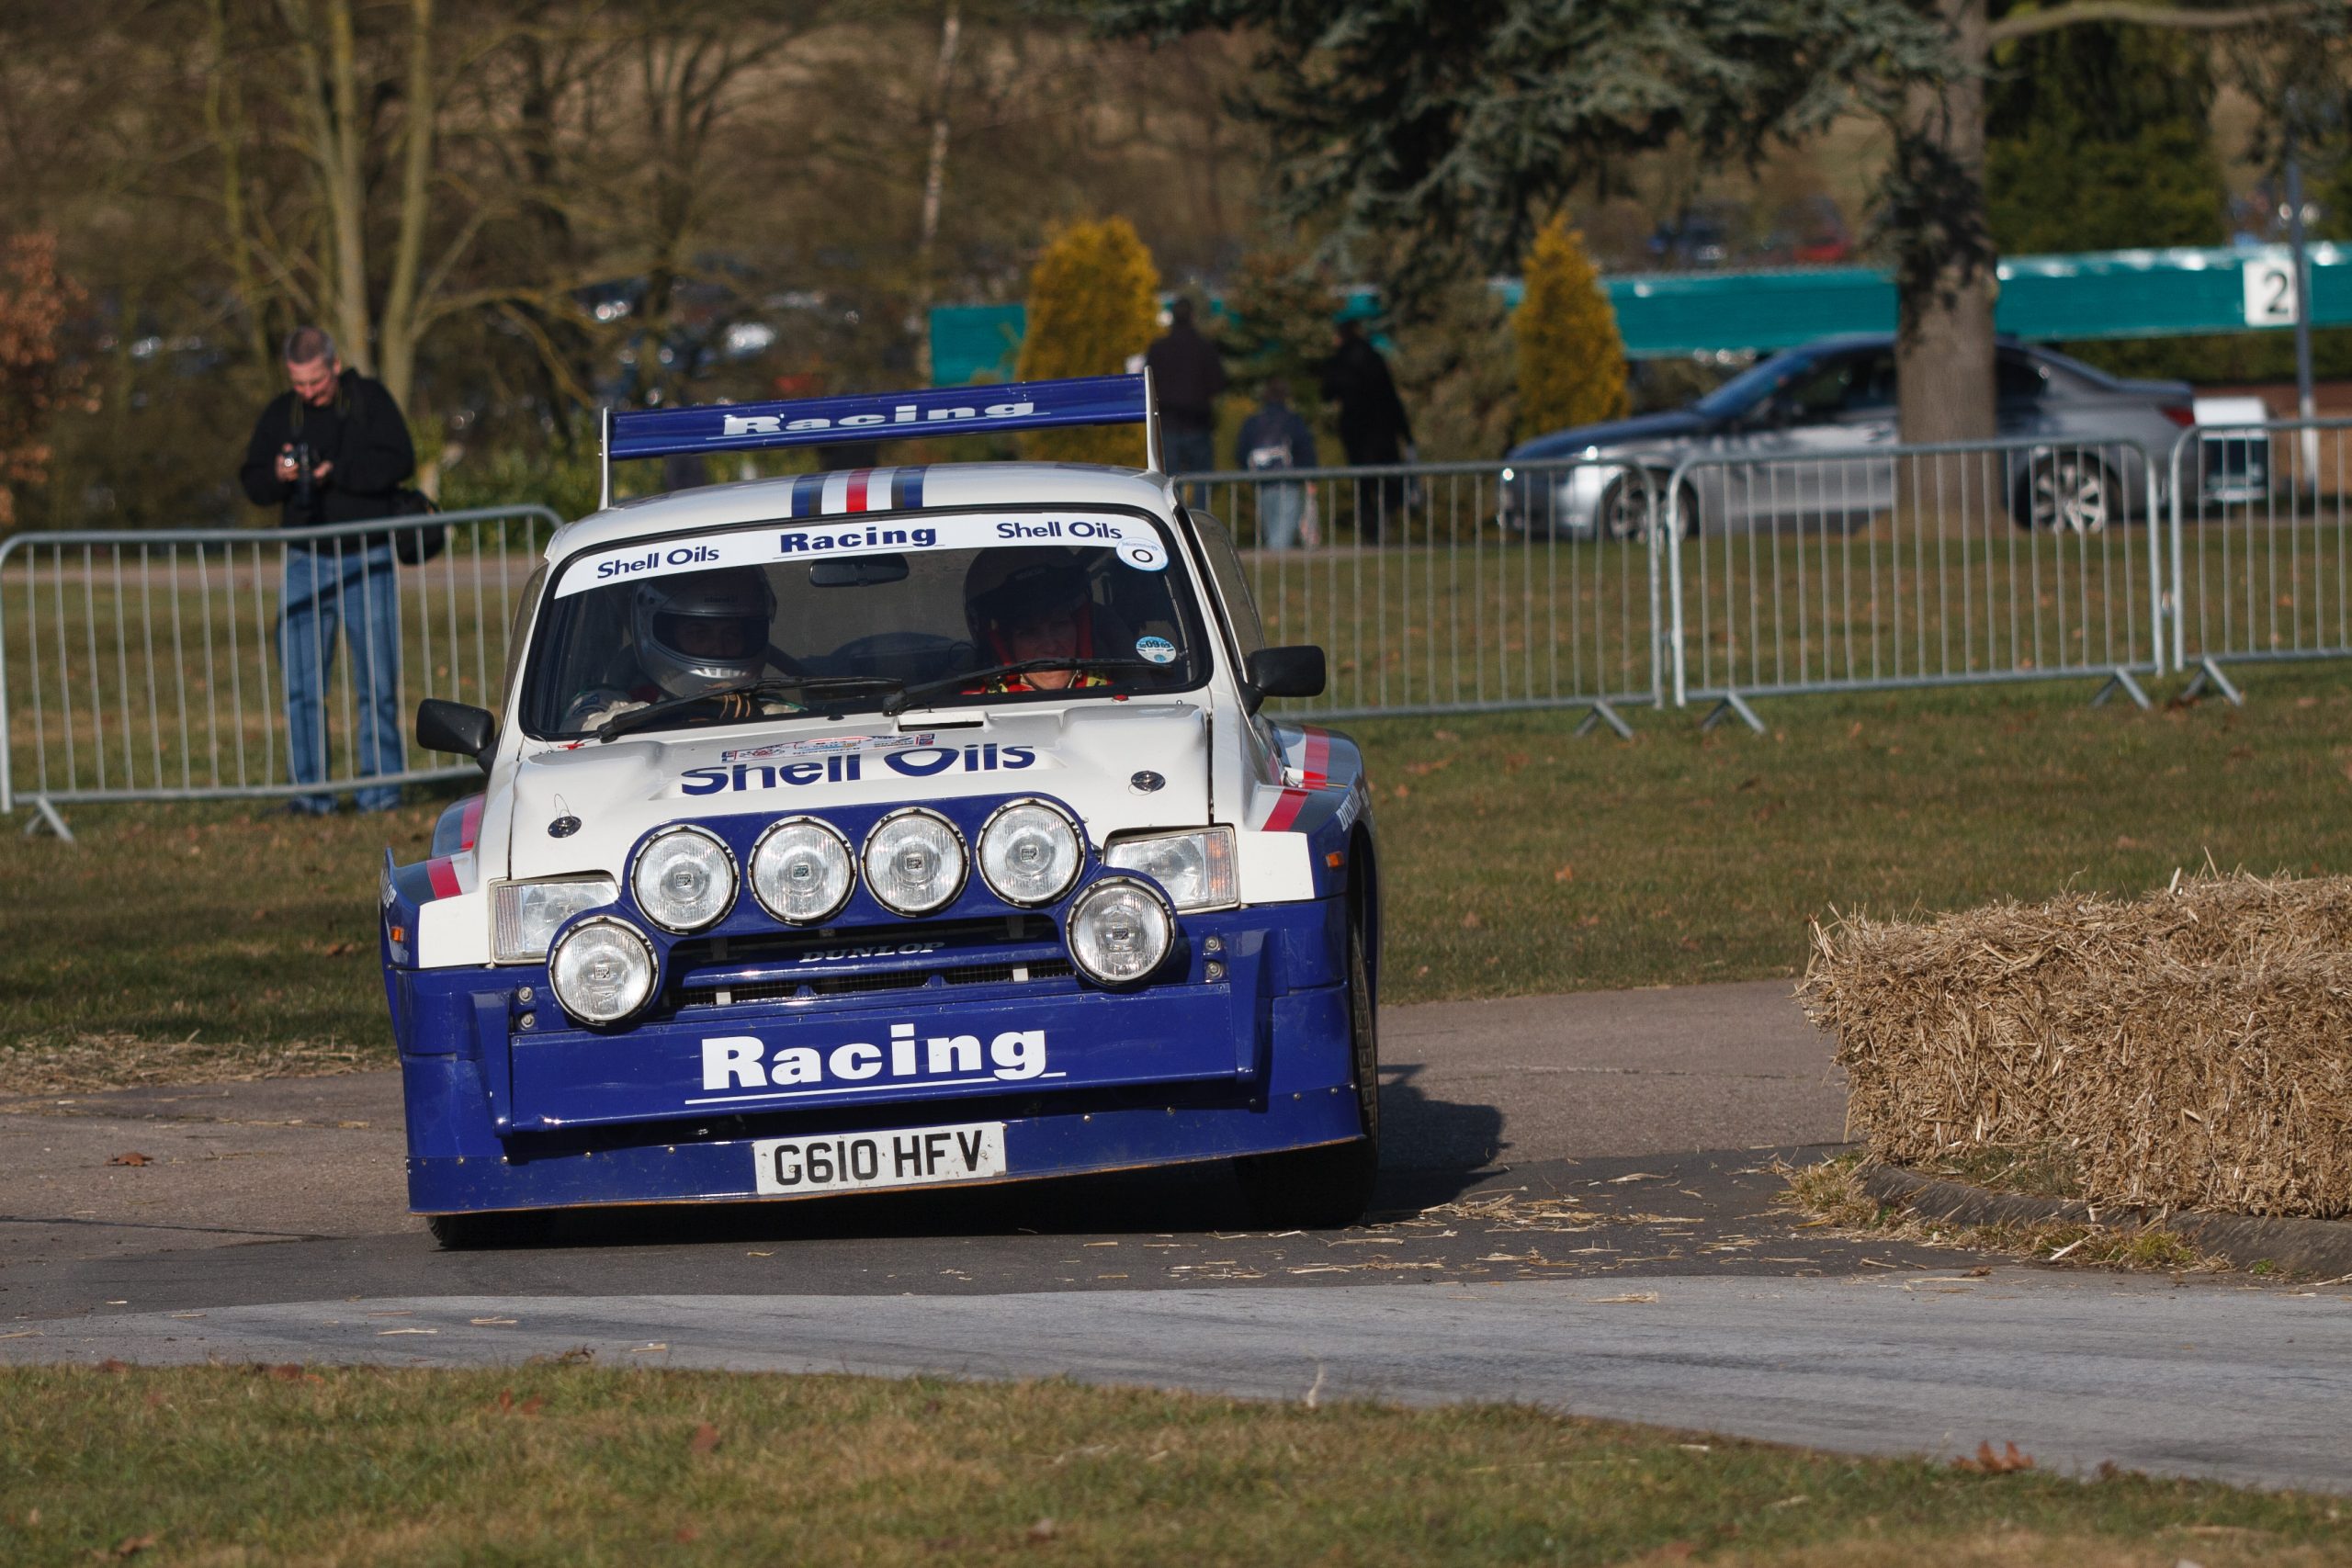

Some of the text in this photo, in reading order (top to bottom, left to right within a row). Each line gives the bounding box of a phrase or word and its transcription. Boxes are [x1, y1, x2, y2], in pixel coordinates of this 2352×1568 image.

[2264, 269, 2289, 314] 2
[724, 403, 1034, 435] Racing
[780, 525, 936, 553] Racing
[996, 521, 1123, 539] Shell Oils
[597, 546, 719, 580] Shell Oils
[680, 742, 1036, 796] Shell Oils
[798, 942, 945, 964] DUNLOP
[701, 1022, 1046, 1090] Racing
[774, 1131, 982, 1186] G610 HFV
